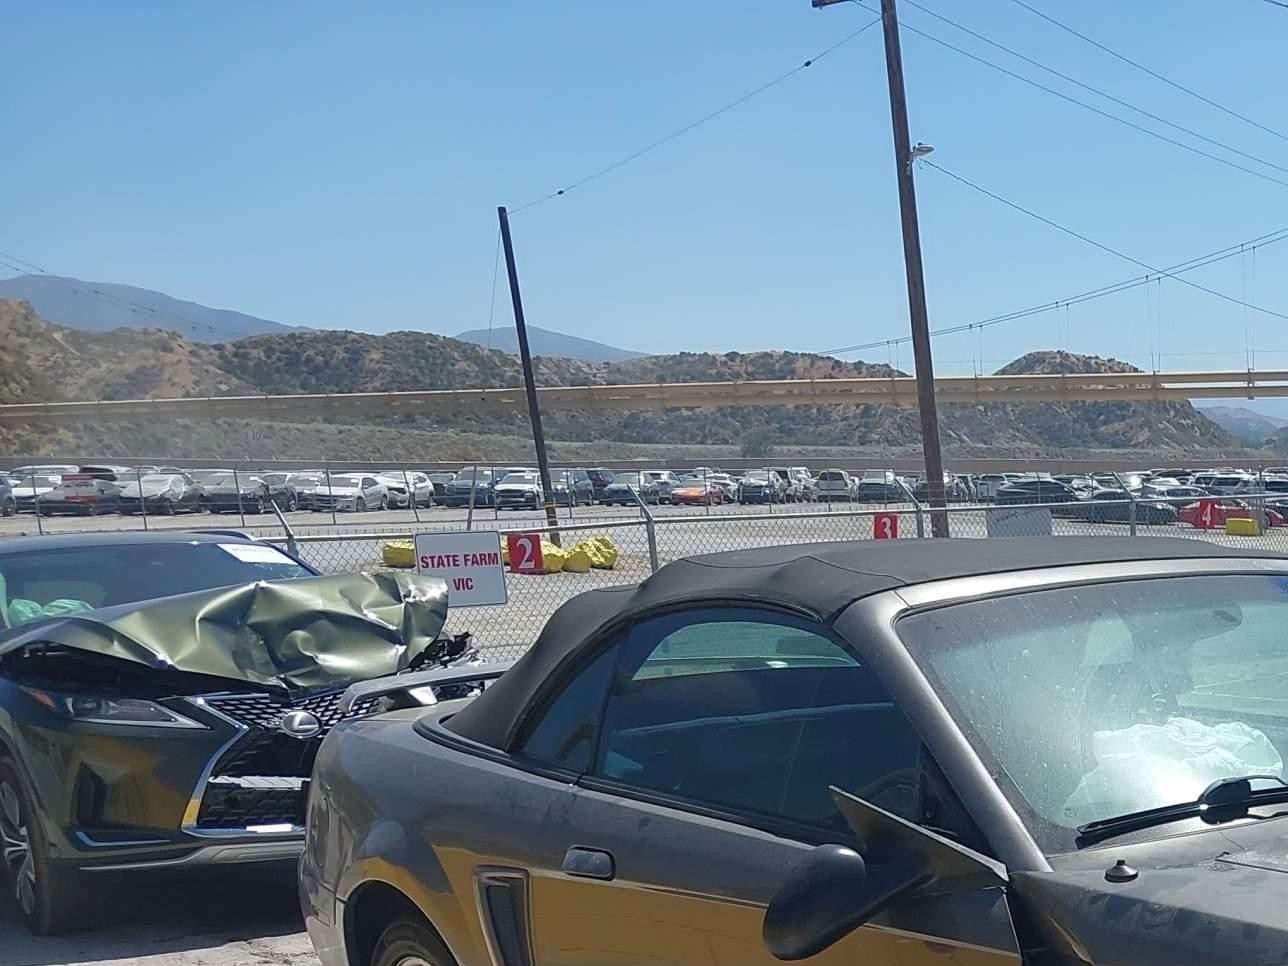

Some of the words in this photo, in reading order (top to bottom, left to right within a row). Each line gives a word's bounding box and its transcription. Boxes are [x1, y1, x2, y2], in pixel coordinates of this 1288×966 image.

[1202, 502, 1211, 525] 4
[421, 554, 460, 568] STATE
[463, 552, 499, 566] FARM
[516, 537, 536, 569] 2
[453, 577, 474, 591] VIC
